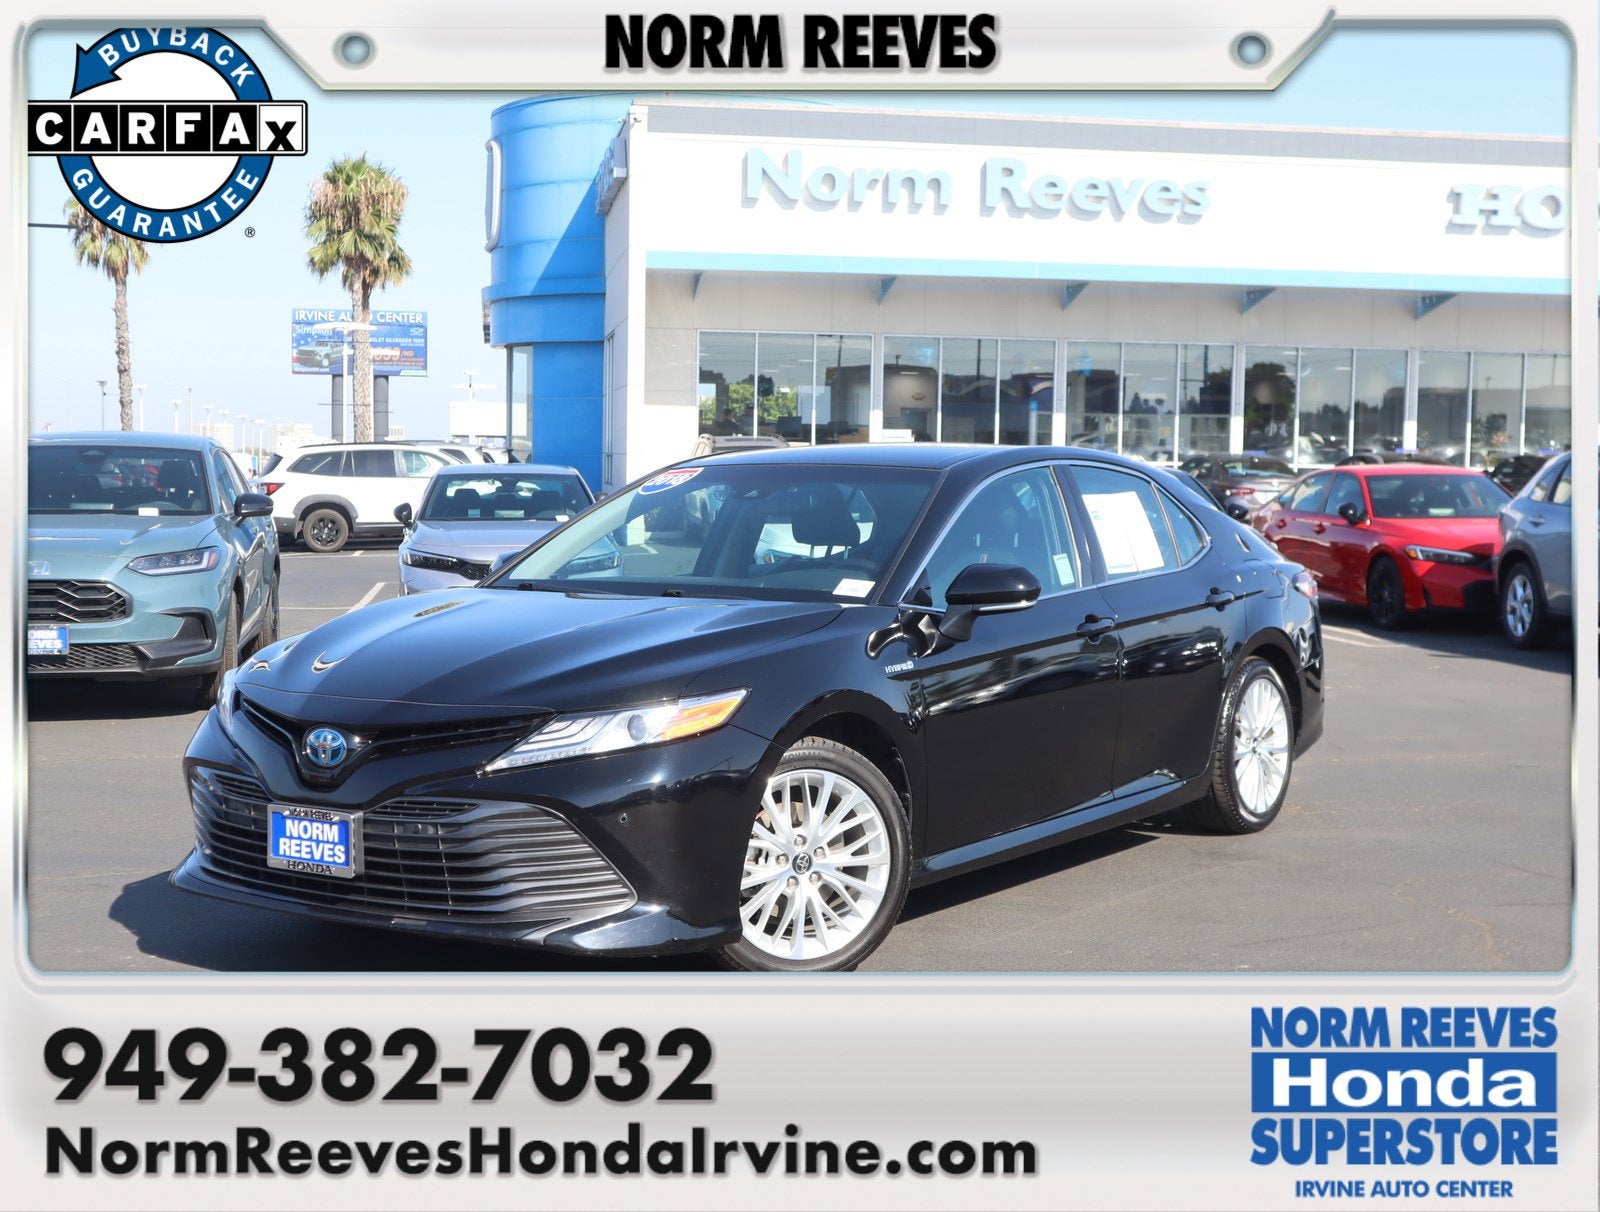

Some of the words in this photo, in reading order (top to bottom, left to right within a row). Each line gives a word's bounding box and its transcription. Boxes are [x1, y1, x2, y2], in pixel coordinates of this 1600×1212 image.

[741, 147, 953, 215] Norm
[979, 156, 1213, 225] Reeves
[294, 310, 335, 322] IRVINE
[376, 311, 423, 324] CENTER
[285, 819, 339, 843] NORM
[278, 837, 346, 864] REEVES
[287, 860, 334, 875] HONDA
